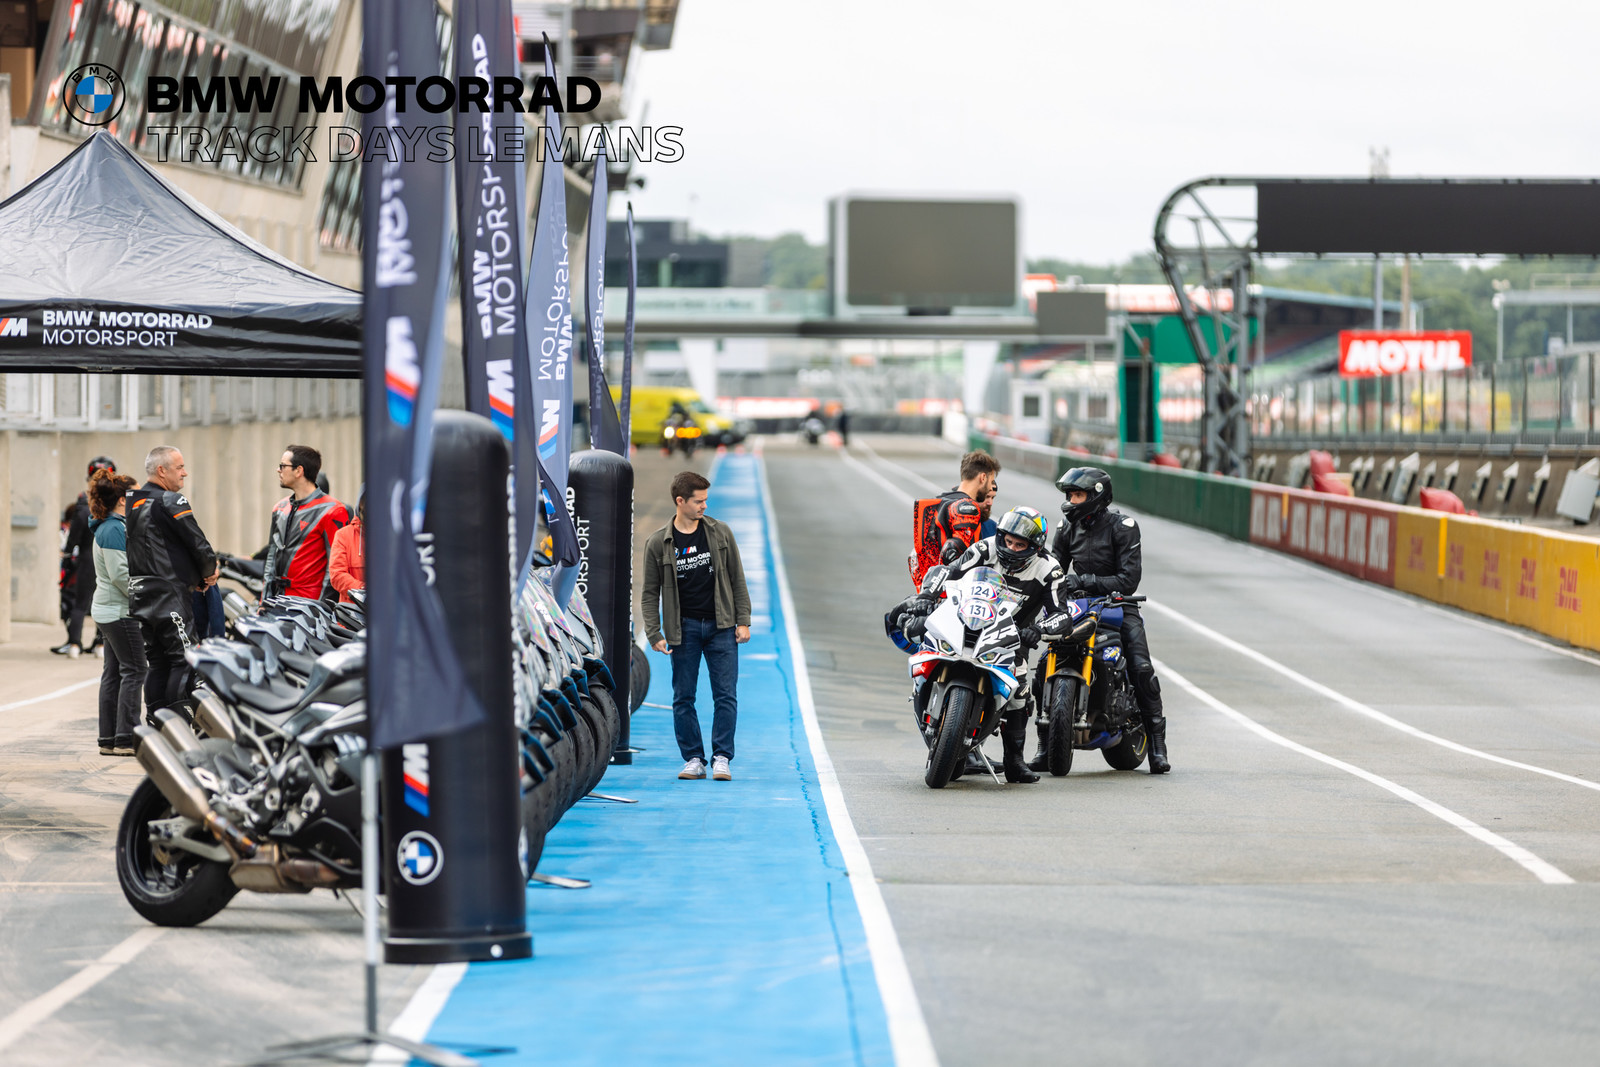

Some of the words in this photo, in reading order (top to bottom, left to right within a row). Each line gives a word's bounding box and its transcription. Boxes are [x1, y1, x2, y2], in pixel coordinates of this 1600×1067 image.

[42, 310, 94, 326] BMW
[99, 311, 213, 329] MOTORRAD
[42, 329, 178, 347] MOTORSPORT
[1344, 339, 1466, 373] MOTUL
[971, 586, 990, 597] 124
[969, 605, 986, 617] 131
